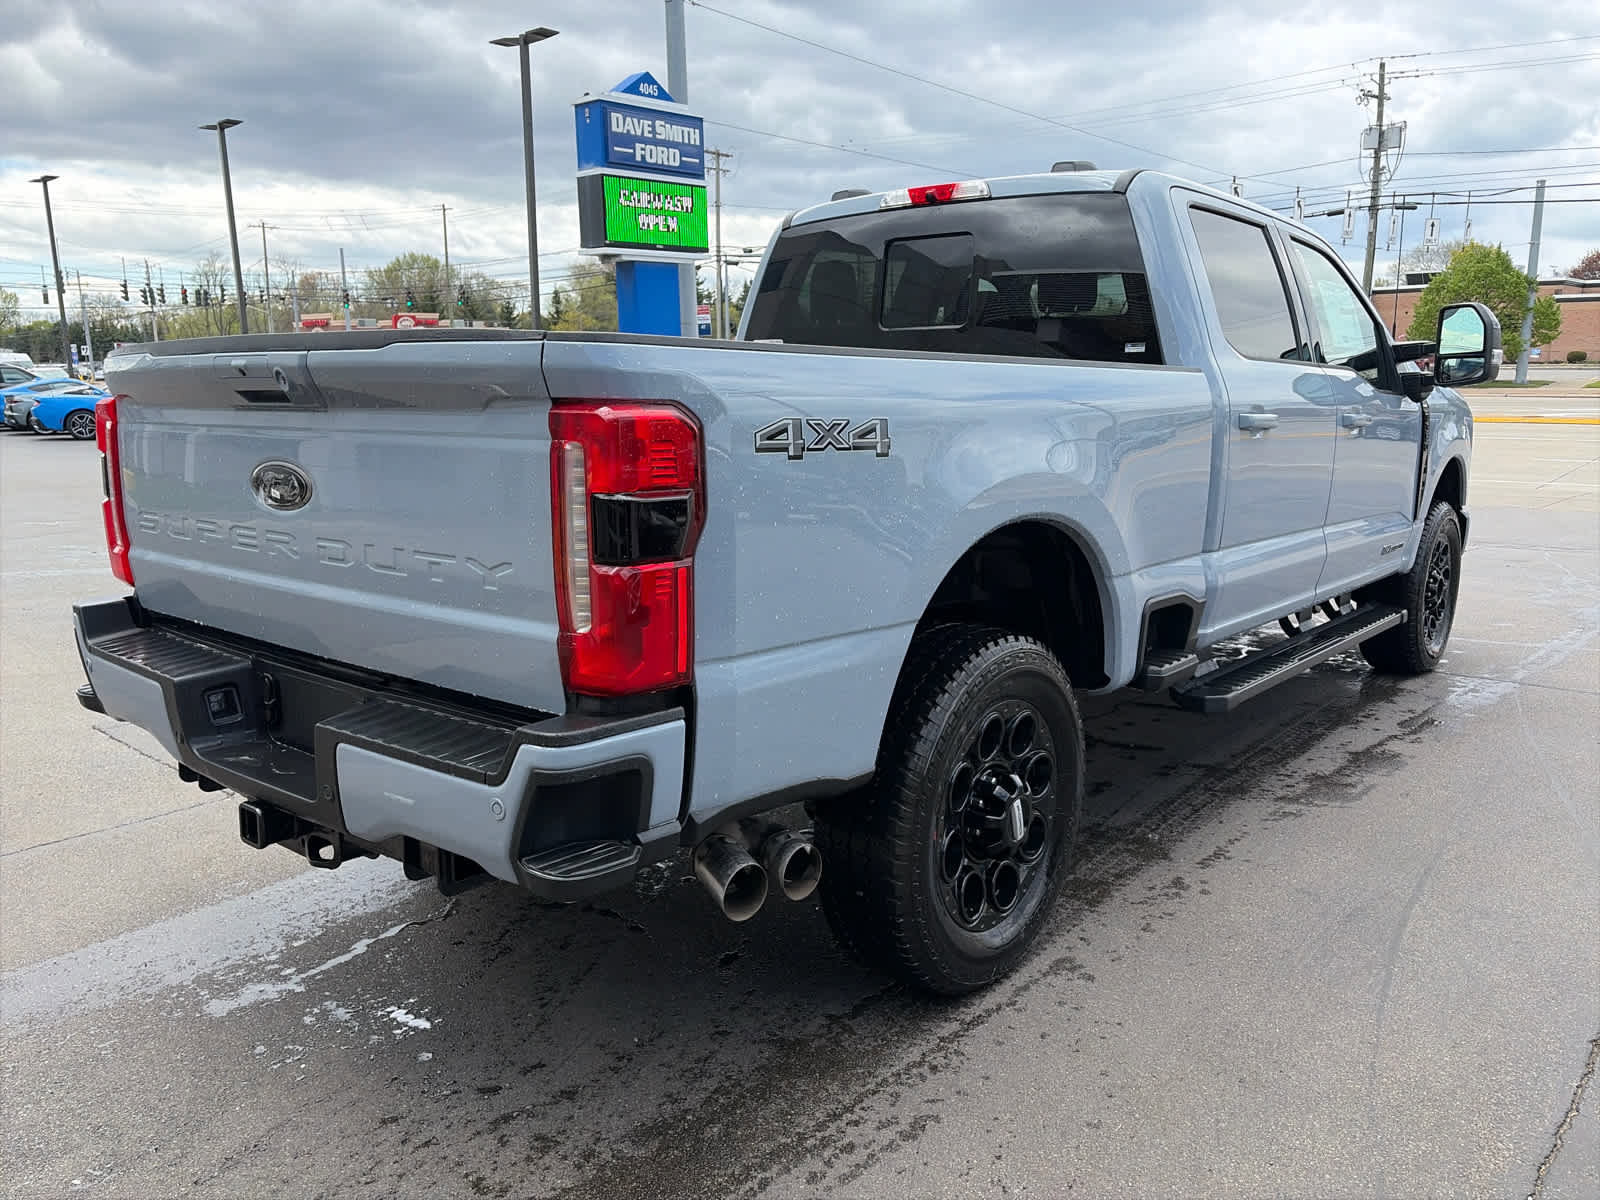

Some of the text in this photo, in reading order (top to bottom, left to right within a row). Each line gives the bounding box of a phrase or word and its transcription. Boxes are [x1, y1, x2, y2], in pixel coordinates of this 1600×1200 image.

[639, 82, 658, 97] 4045
[611, 112, 653, 137] DAVE
[655, 120, 700, 145] SMITH
[635, 143, 680, 167] FORD
[137, 510, 513, 592] SUPER DUTY
